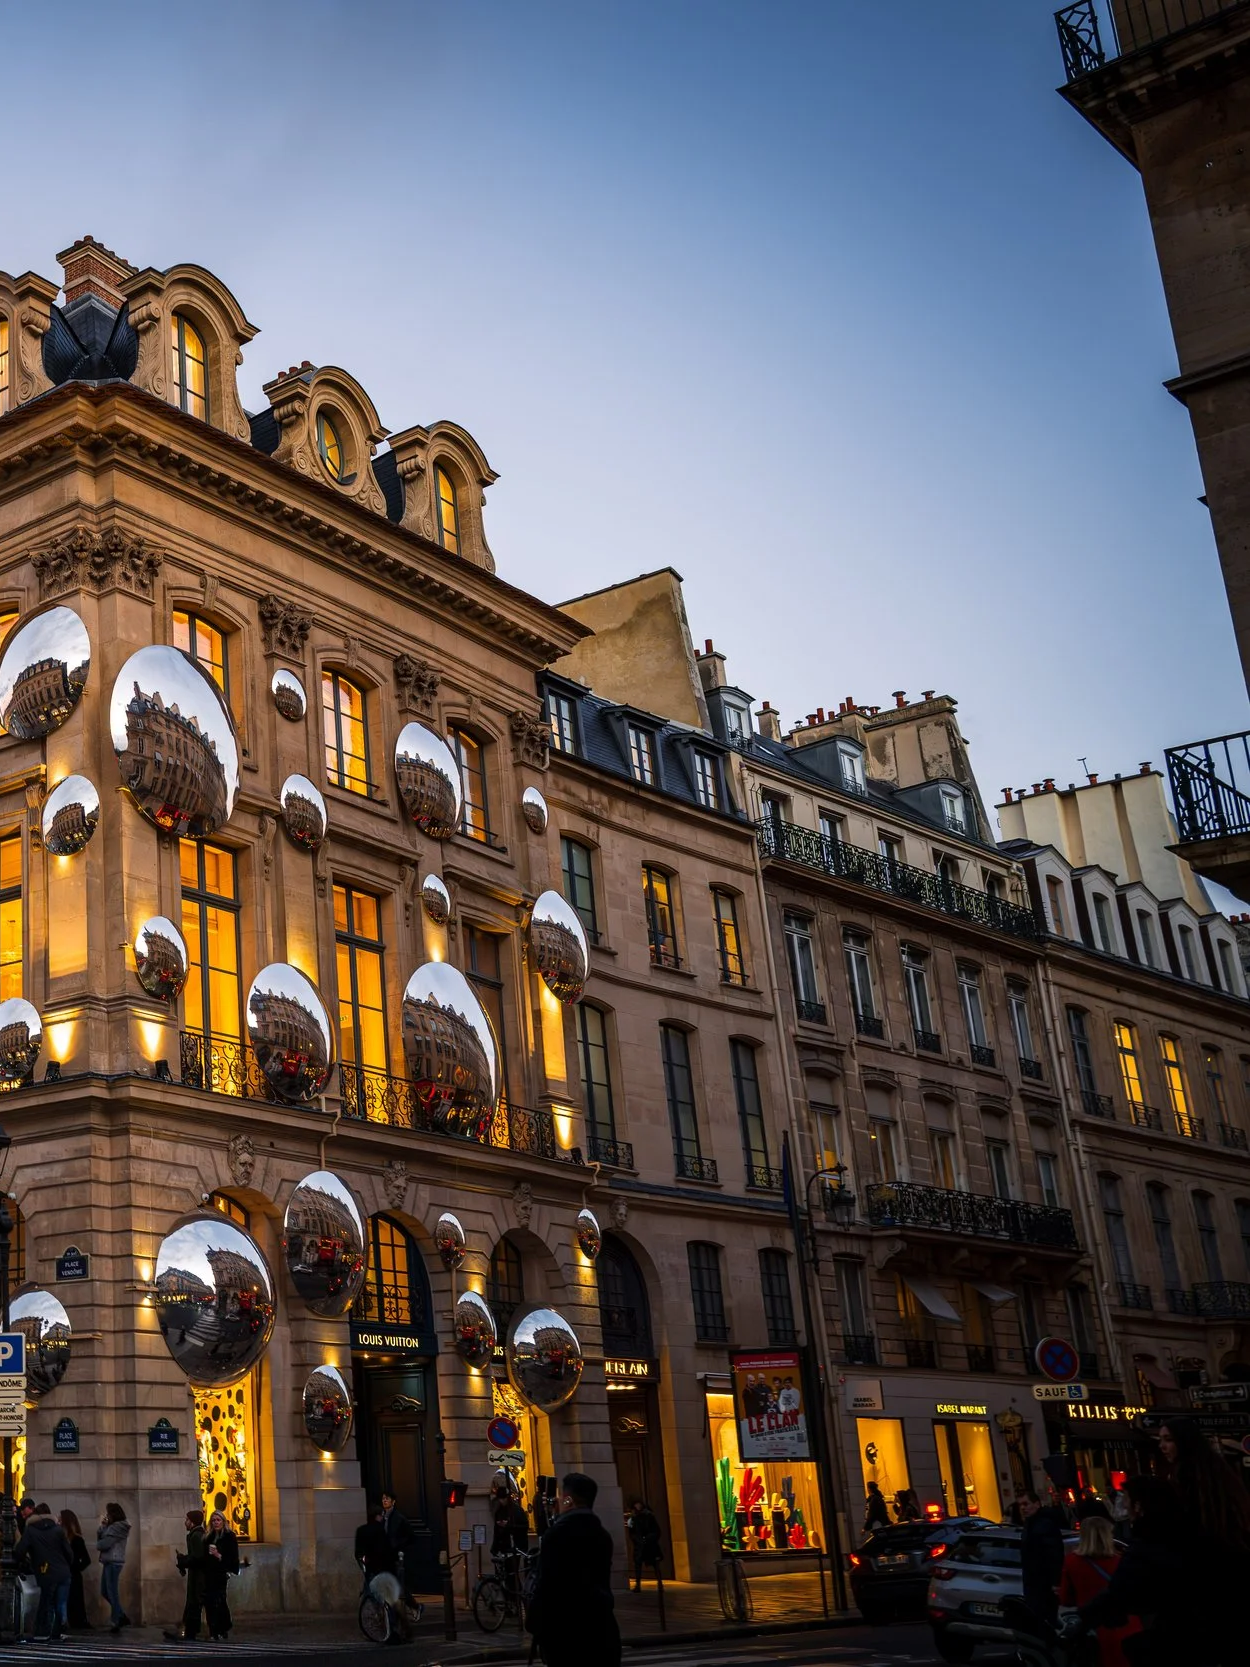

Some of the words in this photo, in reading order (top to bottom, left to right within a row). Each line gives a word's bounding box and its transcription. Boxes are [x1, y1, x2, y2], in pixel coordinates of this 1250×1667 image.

[64, 1260, 79, 1268] PLACE
[358, 1333, 383, 1346] LOUIS
[384, 1335, 419, 1349] VUITTON
[1035, 1387, 1066, 1397] SAUF
[936, 1404, 960, 1414] ISABEL
[960, 1405, 987, 1415] MARANT
[748, 1414, 765, 1434] LE
[766, 1409, 799, 1431] CLAN
[59, 1432, 73, 1440] PLACE
